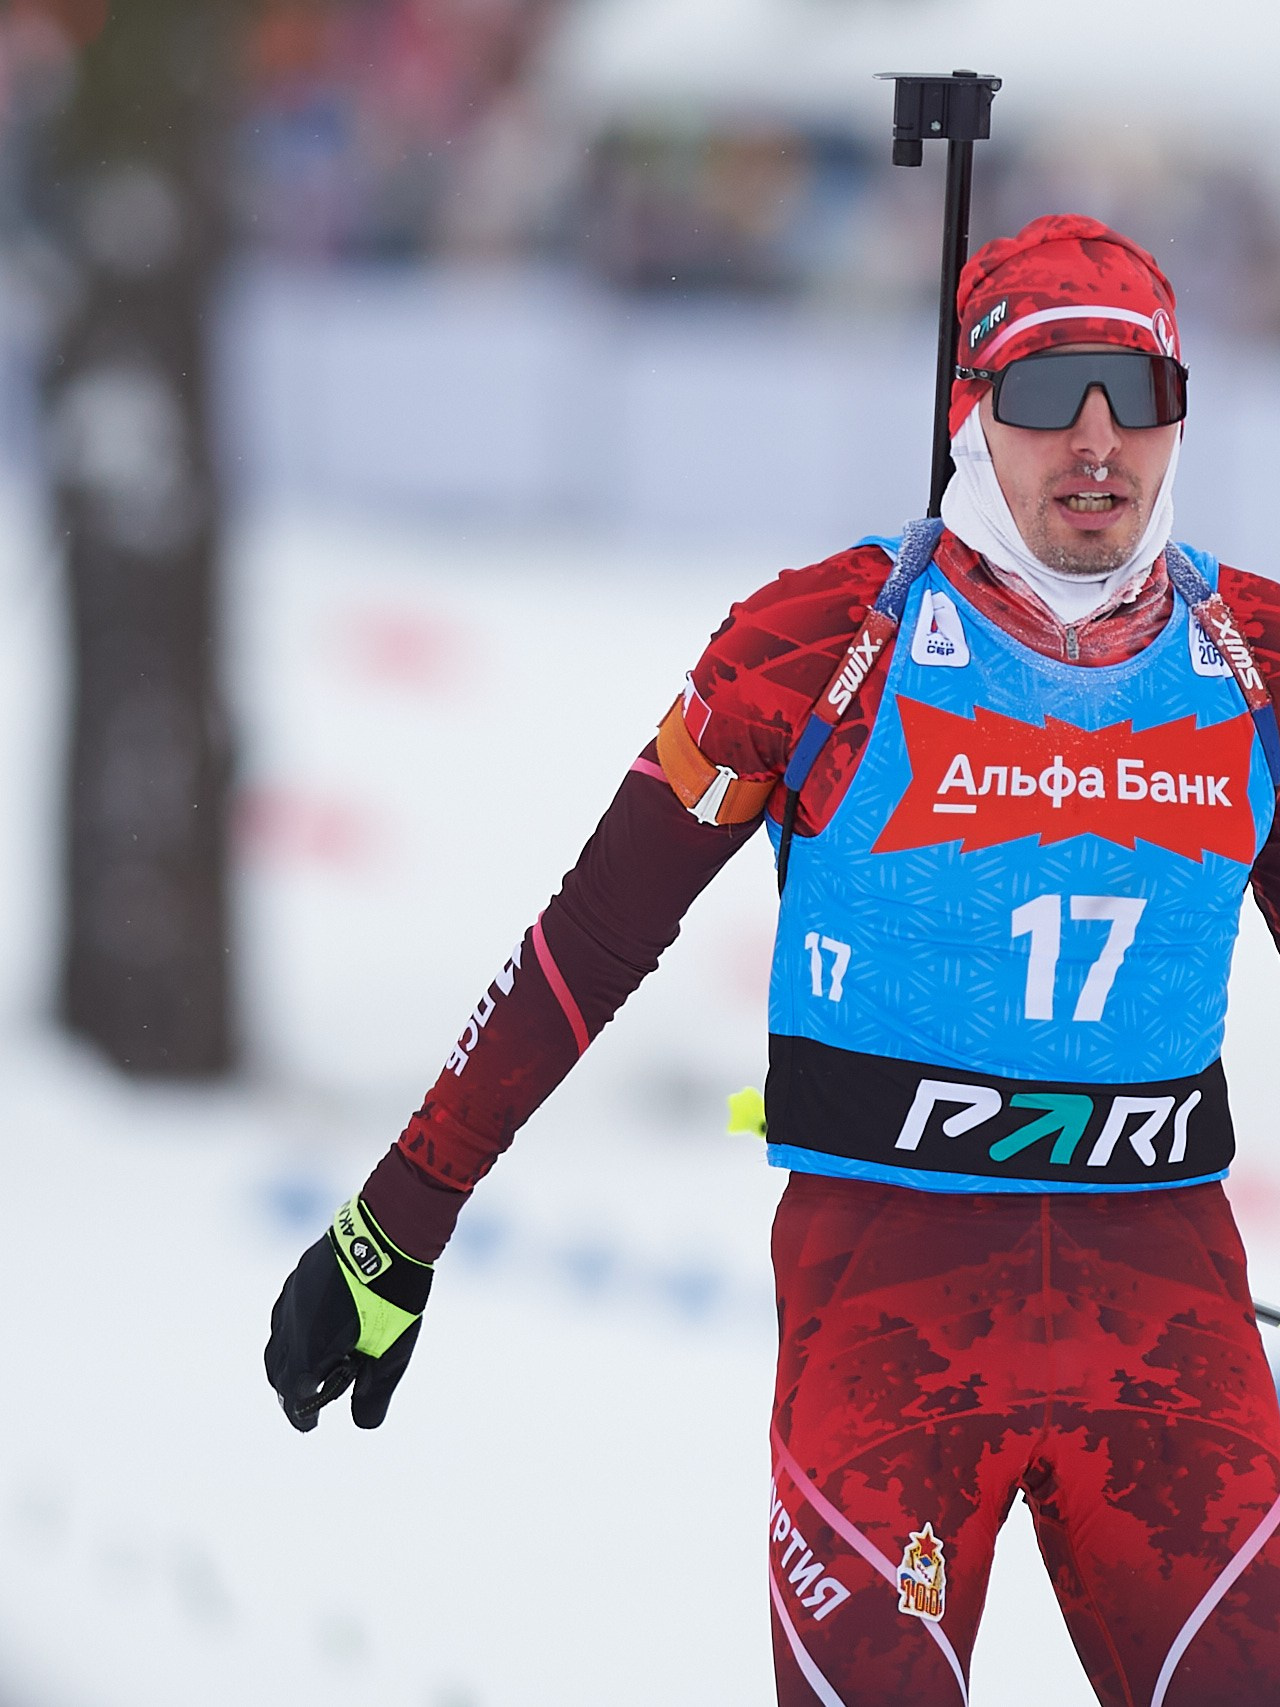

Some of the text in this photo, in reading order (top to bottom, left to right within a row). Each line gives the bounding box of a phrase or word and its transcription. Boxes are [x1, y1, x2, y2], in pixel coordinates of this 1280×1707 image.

[970, 301, 1007, 348] PARI
[936, 754, 1233, 808] Альфа Банк
[805, 931, 852, 1003] 17
[1012, 894, 1148, 1022] 17
[895, 1078, 1202, 1168] PARI
[903, 1579, 940, 1616] 100
